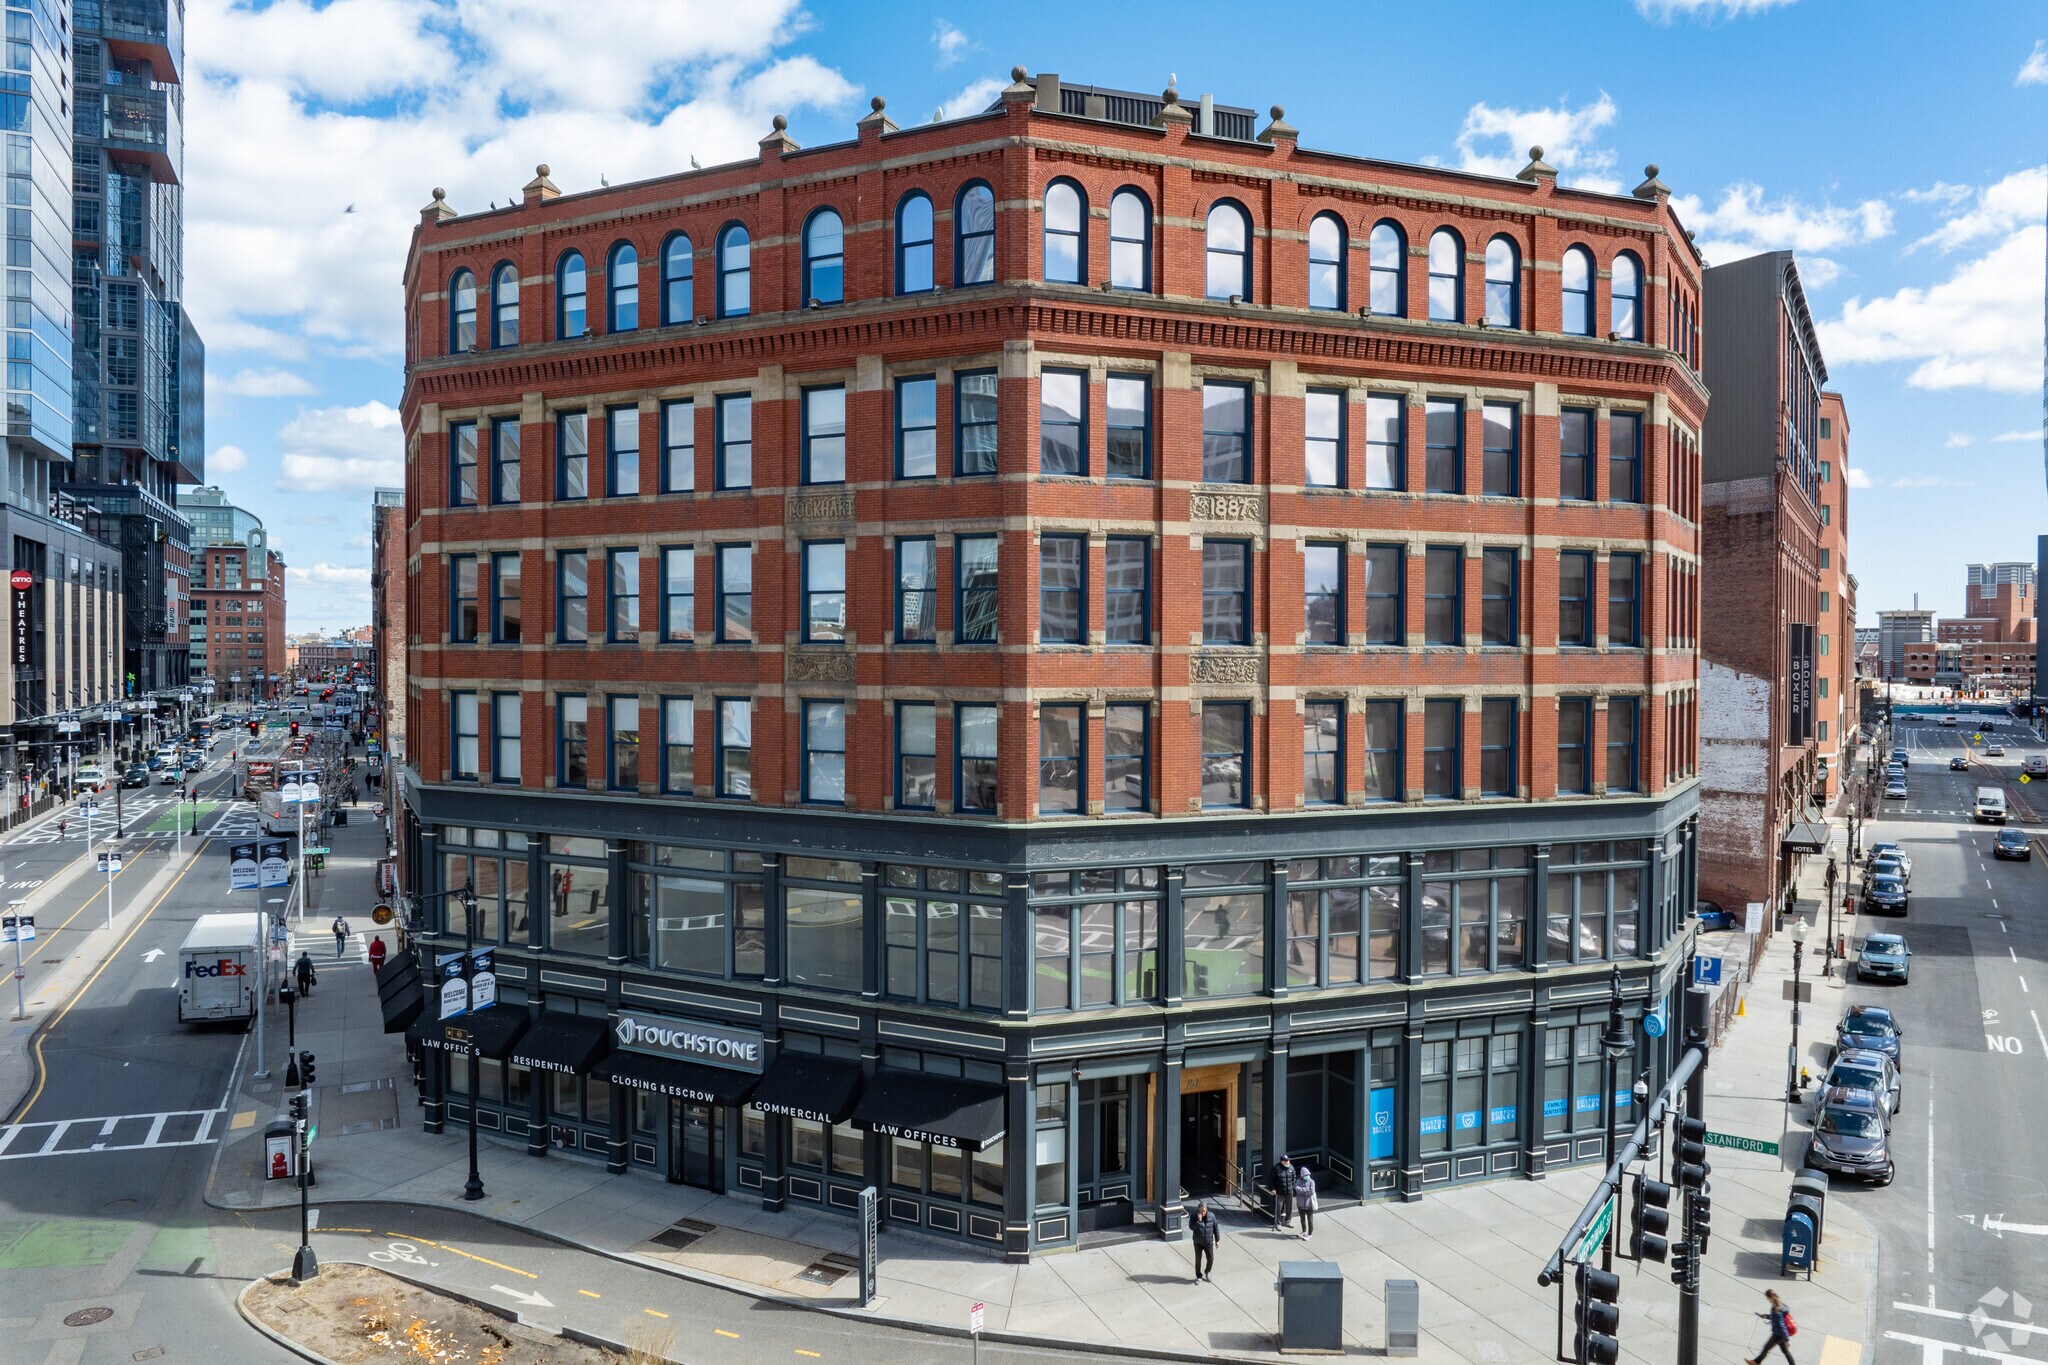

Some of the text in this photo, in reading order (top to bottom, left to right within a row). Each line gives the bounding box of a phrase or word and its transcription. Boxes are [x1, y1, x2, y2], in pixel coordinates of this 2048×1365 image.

[789, 497, 855, 519] LOCKHART
[1209, 496, 1248, 518] 1887
[18, 592, 26, 662] THEATRES
[1793, 661, 1801, 714] BOXER
[1803, 660, 1811, 708] BOXER
[185, 958, 247, 978] FedEx
[1700, 957, 1712, 977] P
[443, 988, 466, 999] WELCOME
[422, 1038, 480, 1056] LAW OFFICS
[635, 1025, 759, 1062] TOUCHSTONE
[513, 1056, 575, 1075] RESIDENTIAL
[611, 1074, 714, 1103] CLOSING & ESCROW
[1576, 1097, 1600, 1105] BOSTON
[1576, 1102, 1600, 1110] SMILES
[755, 1101, 832, 1124] COMMERCIAL
[1491, 1109, 1516, 1117] BOSTON
[1491, 1114, 1515, 1122] SMILES
[1420, 1119, 1447, 1127] BOSTON
[1421, 1124, 1446, 1132] SMILES
[872, 1122, 957, 1147] LAW OFFICES
[1706, 1133, 1764, 1152] STANIFORD
